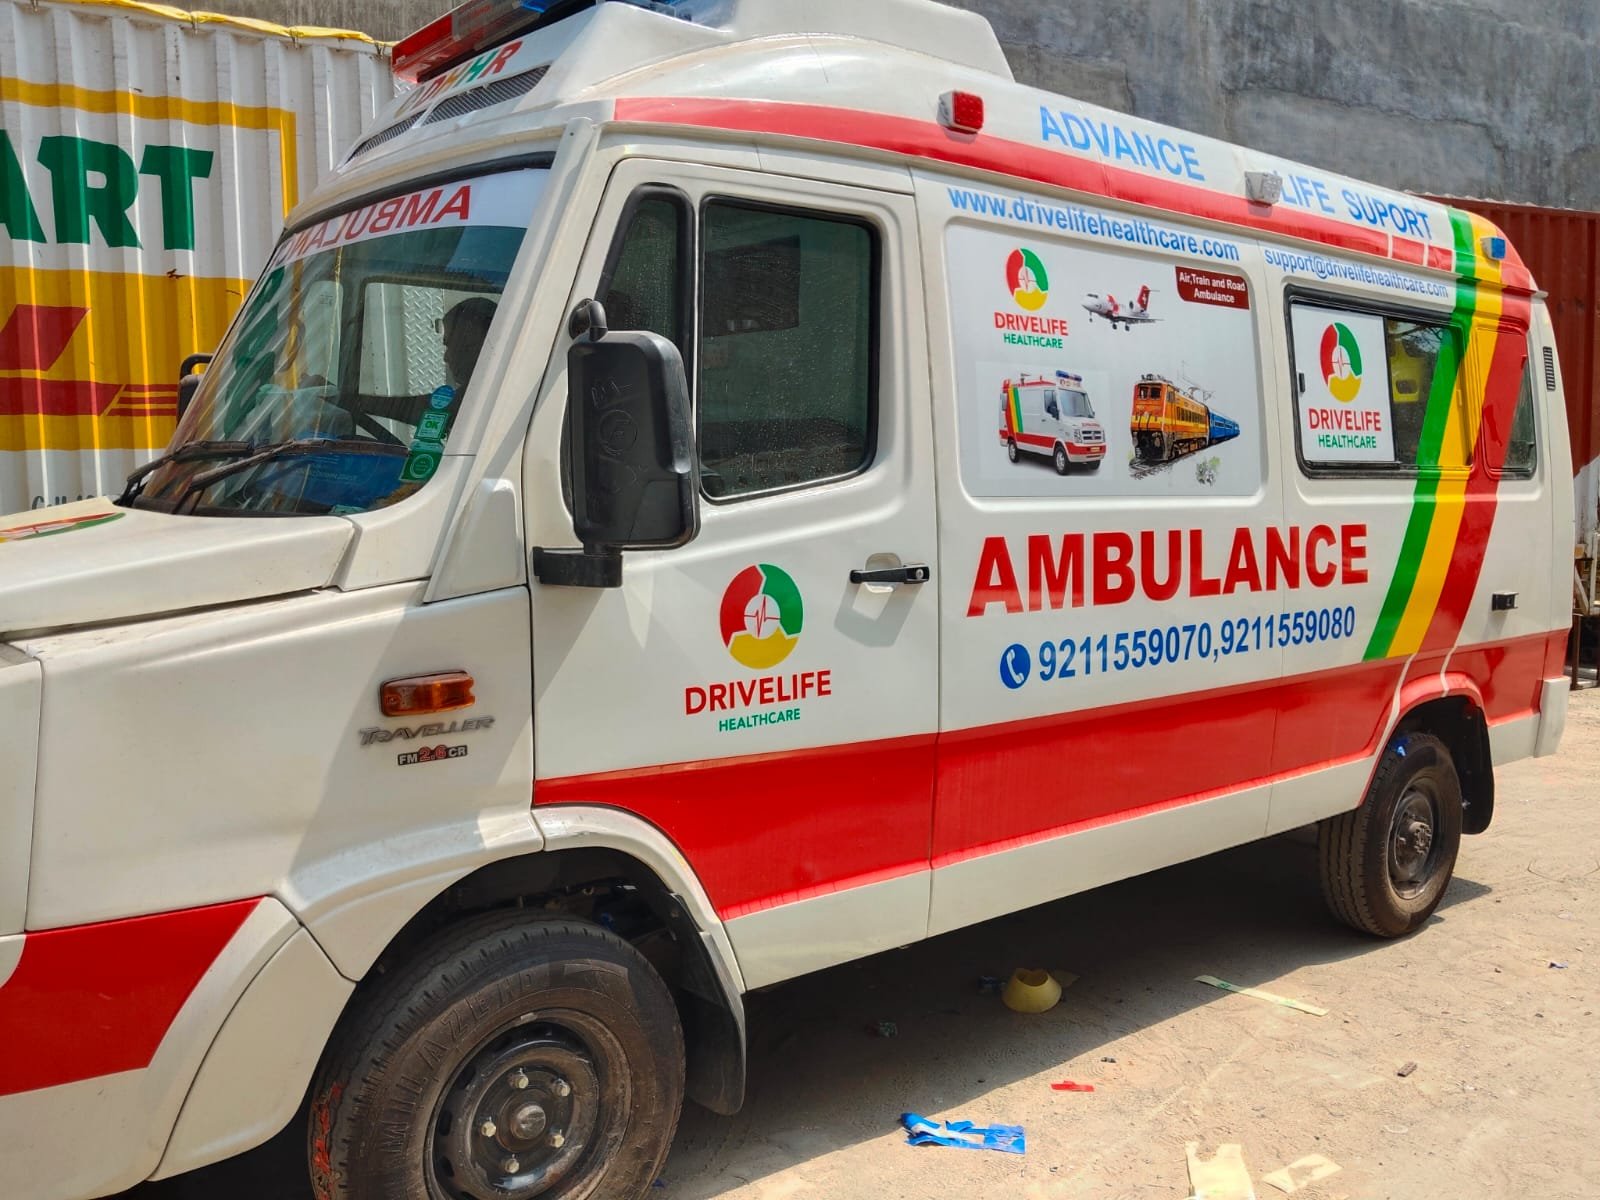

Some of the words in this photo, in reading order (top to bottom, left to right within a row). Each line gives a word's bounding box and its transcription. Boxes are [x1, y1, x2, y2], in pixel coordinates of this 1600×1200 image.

[1039, 104, 1206, 182] ADVANCE
[1273, 170, 1336, 214] LIFE
[1339, 186, 1431, 238] SUPORT
[947, 186, 1240, 262] www.drivelifehealthcare.com
[1211, 278, 1225, 289] and
[1226, 279, 1246, 292] Road
[1263, 248, 1449, 299] support@drivelifehealthcare.com
[1193, 287, 1235, 303] Ambulance
[993, 311, 1069, 336] DRIVELIFE
[1003, 333, 1063, 349] HEALTHCARE
[1308, 408, 1381, 432] DRIVELIFE
[1317, 434, 1376, 449] HEALTHCARE
[966, 523, 1369, 618] AMBULANCE
[684, 669, 832, 716] DRIVELIFE
[358, 715, 495, 746] TRAVELLER
[718, 707, 801, 733] HEALTHCARE
